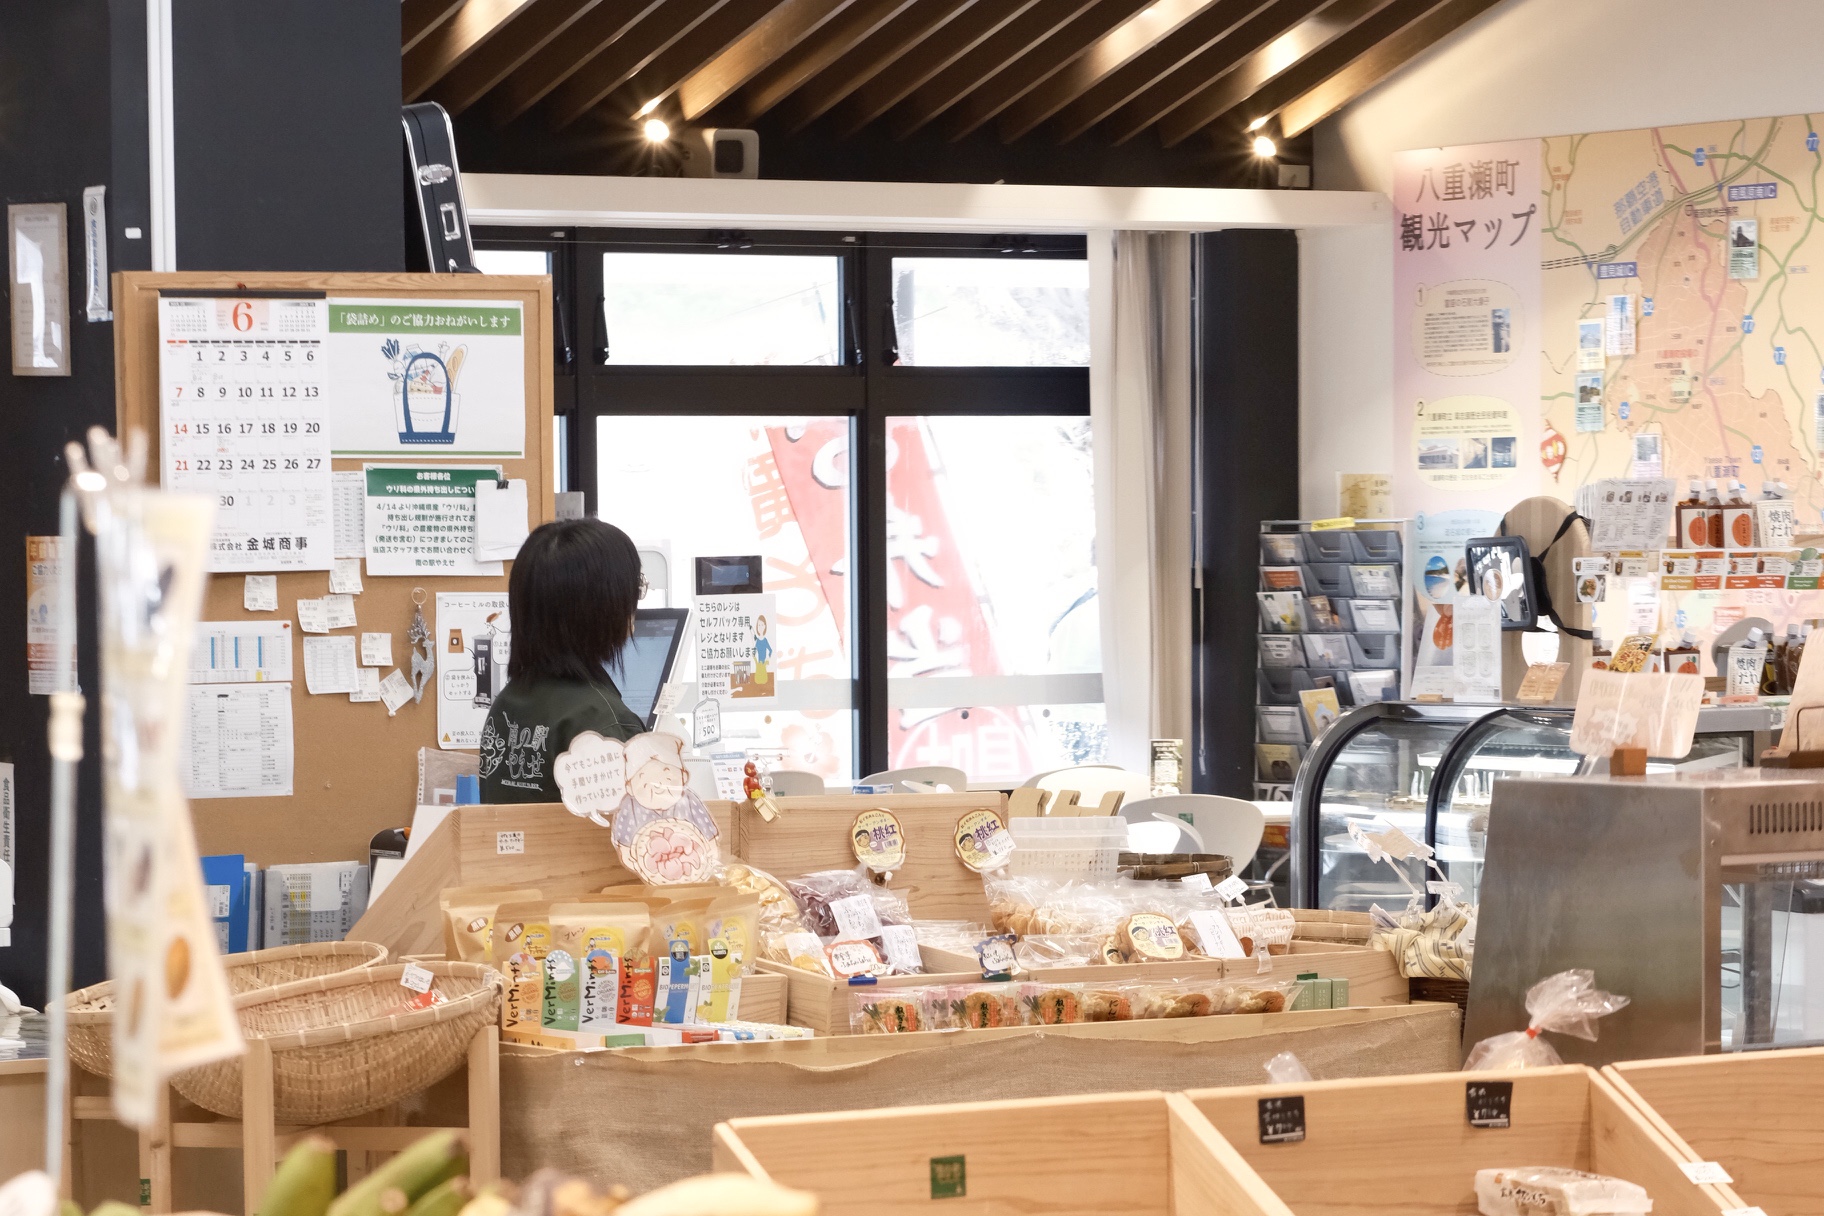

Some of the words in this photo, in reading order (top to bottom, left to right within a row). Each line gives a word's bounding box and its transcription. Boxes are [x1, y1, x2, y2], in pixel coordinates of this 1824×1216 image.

[1416, 160, 1519, 202] 八重瀬町
[1401, 203, 1537, 251] 観光マップ
[232, 302, 253, 332] 6
[339, 312, 511, 328] 「袋詰め」のご協力おねがいします
[197, 351, 203, 361] 1
[218, 351, 226, 361] 2
[240, 351, 248, 361] 3
[262, 351, 270, 361] 4
[284, 351, 292, 361] 5
[306, 351, 314, 361] 6
[175, 387, 183, 397] 7
[197, 387, 205, 397] 8
[219, 387, 227, 397] 9
[238, 387, 252, 397] 10
[260, 387, 274, 397] 11
[282, 387, 297, 397] 12
[304, 387, 319, 397] 13
[1417, 401, 1424, 416] 2
[174, 424, 188, 434] 14
[195, 424, 210, 434] 15
[217, 424, 232, 434] 16
[239, 424, 253, 434] 17
[261, 423, 276, 433] 18
[283, 423, 298, 433] 19
[305, 423, 320, 433] 20
[175, 460, 189, 470] 21
[196, 460, 211, 470] 22
[218, 460, 233, 470] 23
[241, 460, 255, 470] 24
[262, 459, 277, 469] 25
[284, 459, 299, 469] 26
[306, 459, 321, 469] 27
[219, 495, 234, 506] 30
[376, 503, 476, 511] 4/14より沖縄県産「ウリ科」
[1768, 510, 1792, 523] 焼肉
[381, 525, 475, 533] 「ウリ科」の農産物の県外持ち
[1771, 523, 1793, 538] だれ
[246, 536, 308, 551] 金城商事
[375, 535, 475, 543] （発送も含む）につきましてのご
[700, 602, 740, 612] こちらのレジは
[700, 616, 750, 628] セルフパック専用
[700, 632, 744, 643] レジとなります
[701, 647, 757, 659] ご協力お願いします
[1736, 657, 1756, 672] 焼肉
[1738, 672, 1760, 685] だれ
[506, 749, 545, 779] やえせ
[873, 824, 898, 841] 桃紅
[975, 819, 1000, 841] 桃紅
[506, 961, 520, 1028] VerMints
[544, 959, 557, 1026] VerMints
[582, 959, 597, 1024] VerMints
[619, 957, 634, 1023] VerMints
